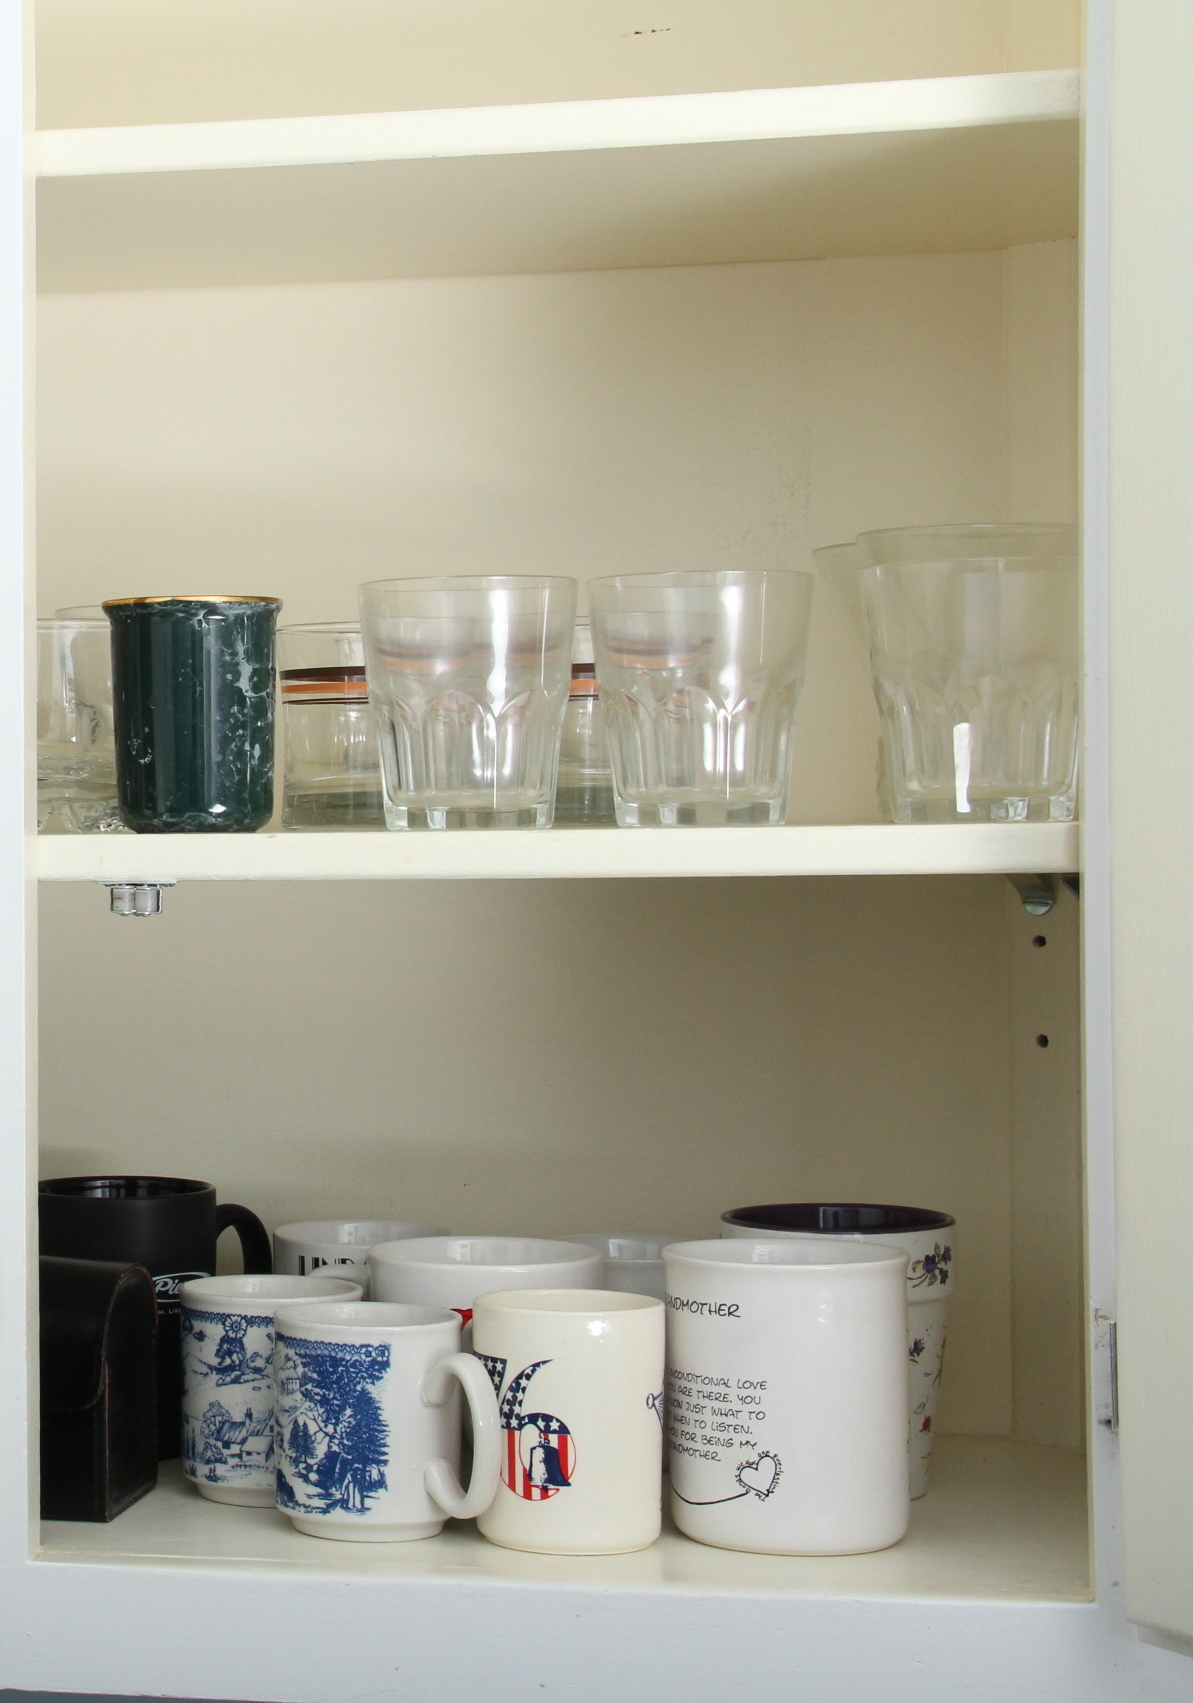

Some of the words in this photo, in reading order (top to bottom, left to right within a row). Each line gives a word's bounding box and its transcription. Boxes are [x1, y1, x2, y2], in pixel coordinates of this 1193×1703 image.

[666, 1293, 741, 1319] ANDMOTHER
[668, 1367, 732, 1389] NCONDITIONAL
[737, 1379, 768, 1391] LOVE
[677, 1385, 693, 1397] ARE
[696, 1390, 733, 1404] THERE.
[737, 1394, 762, 1406] YOU
[685, 1401, 707, 1415] JUST
[711, 1405, 743, 1420] WHAT
[747, 1410, 766, 1421] TO
[693, 1418, 707, 1430] TO
[711, 1421, 753, 1435] LISTEN.
[680, 1429, 698, 1443] FOR
[701, 1434, 734, 1448] BEING
[739, 1439, 757, 1451] MY
